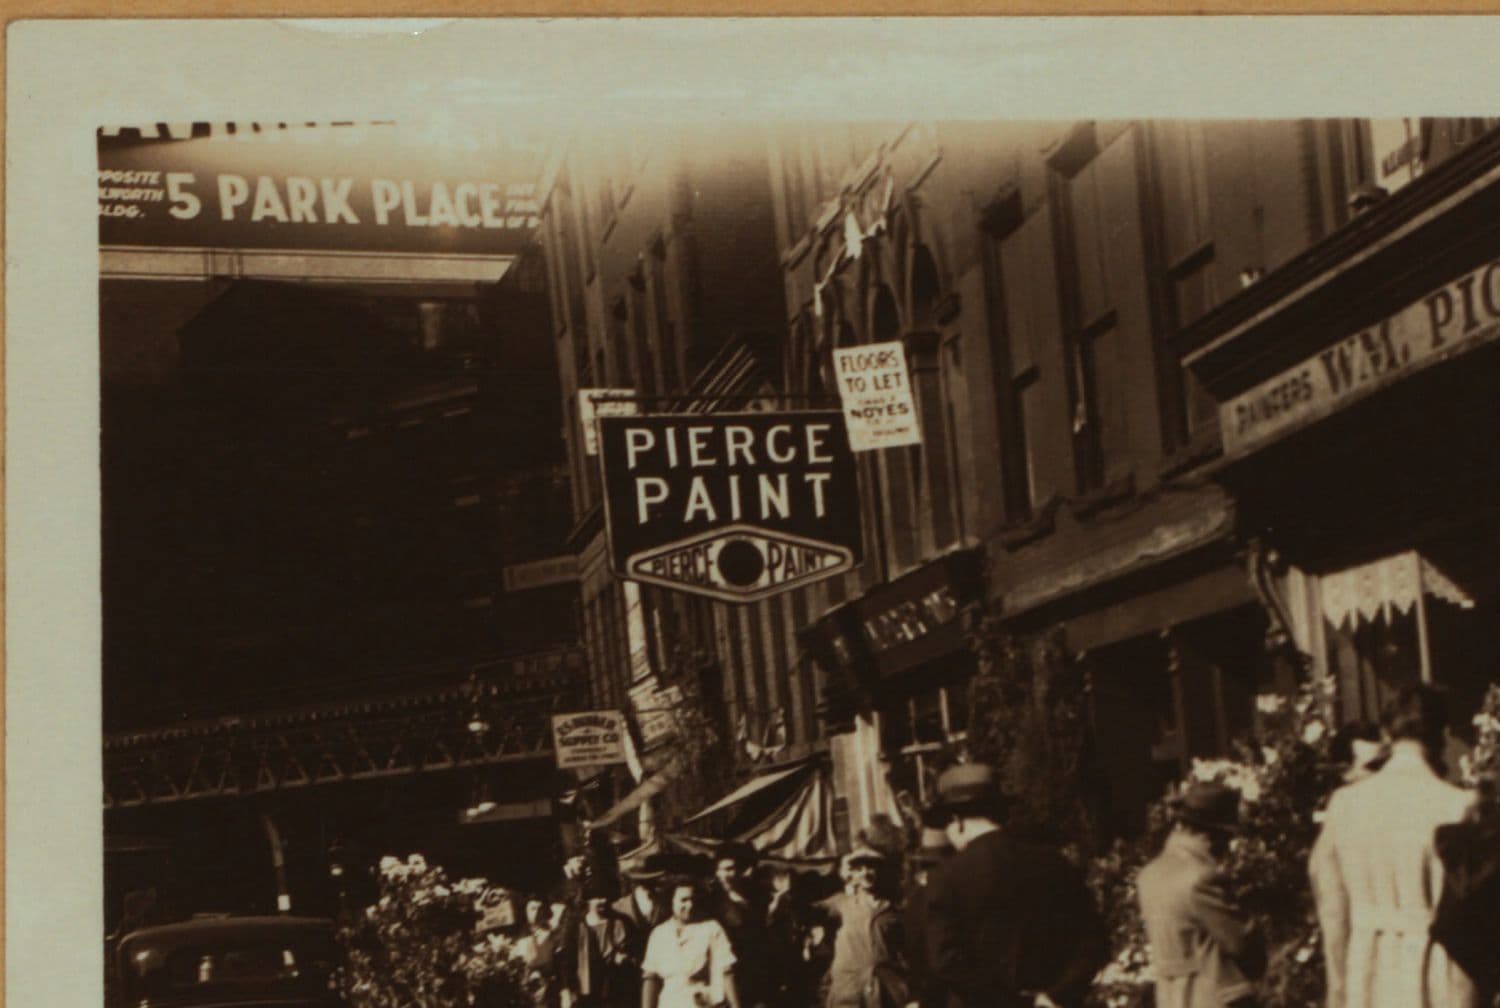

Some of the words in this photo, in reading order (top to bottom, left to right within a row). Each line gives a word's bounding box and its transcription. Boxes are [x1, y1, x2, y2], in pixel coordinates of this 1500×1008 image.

[166, 172, 201, 220] 5
[216, 174, 360, 224] PARK
[371, 179, 504, 229] PLACE
[840, 350, 900, 374] FLOORS
[845, 376, 867, 393] TO
[873, 371, 902, 391] LET
[850, 402, 909, 419] NOYES
[625, 424, 834, 470] PIERCE
[635, 472, 832, 525] PAINT
[652, 542, 717, 590] PIERCE
[765, 541, 824, 585] PAINT
